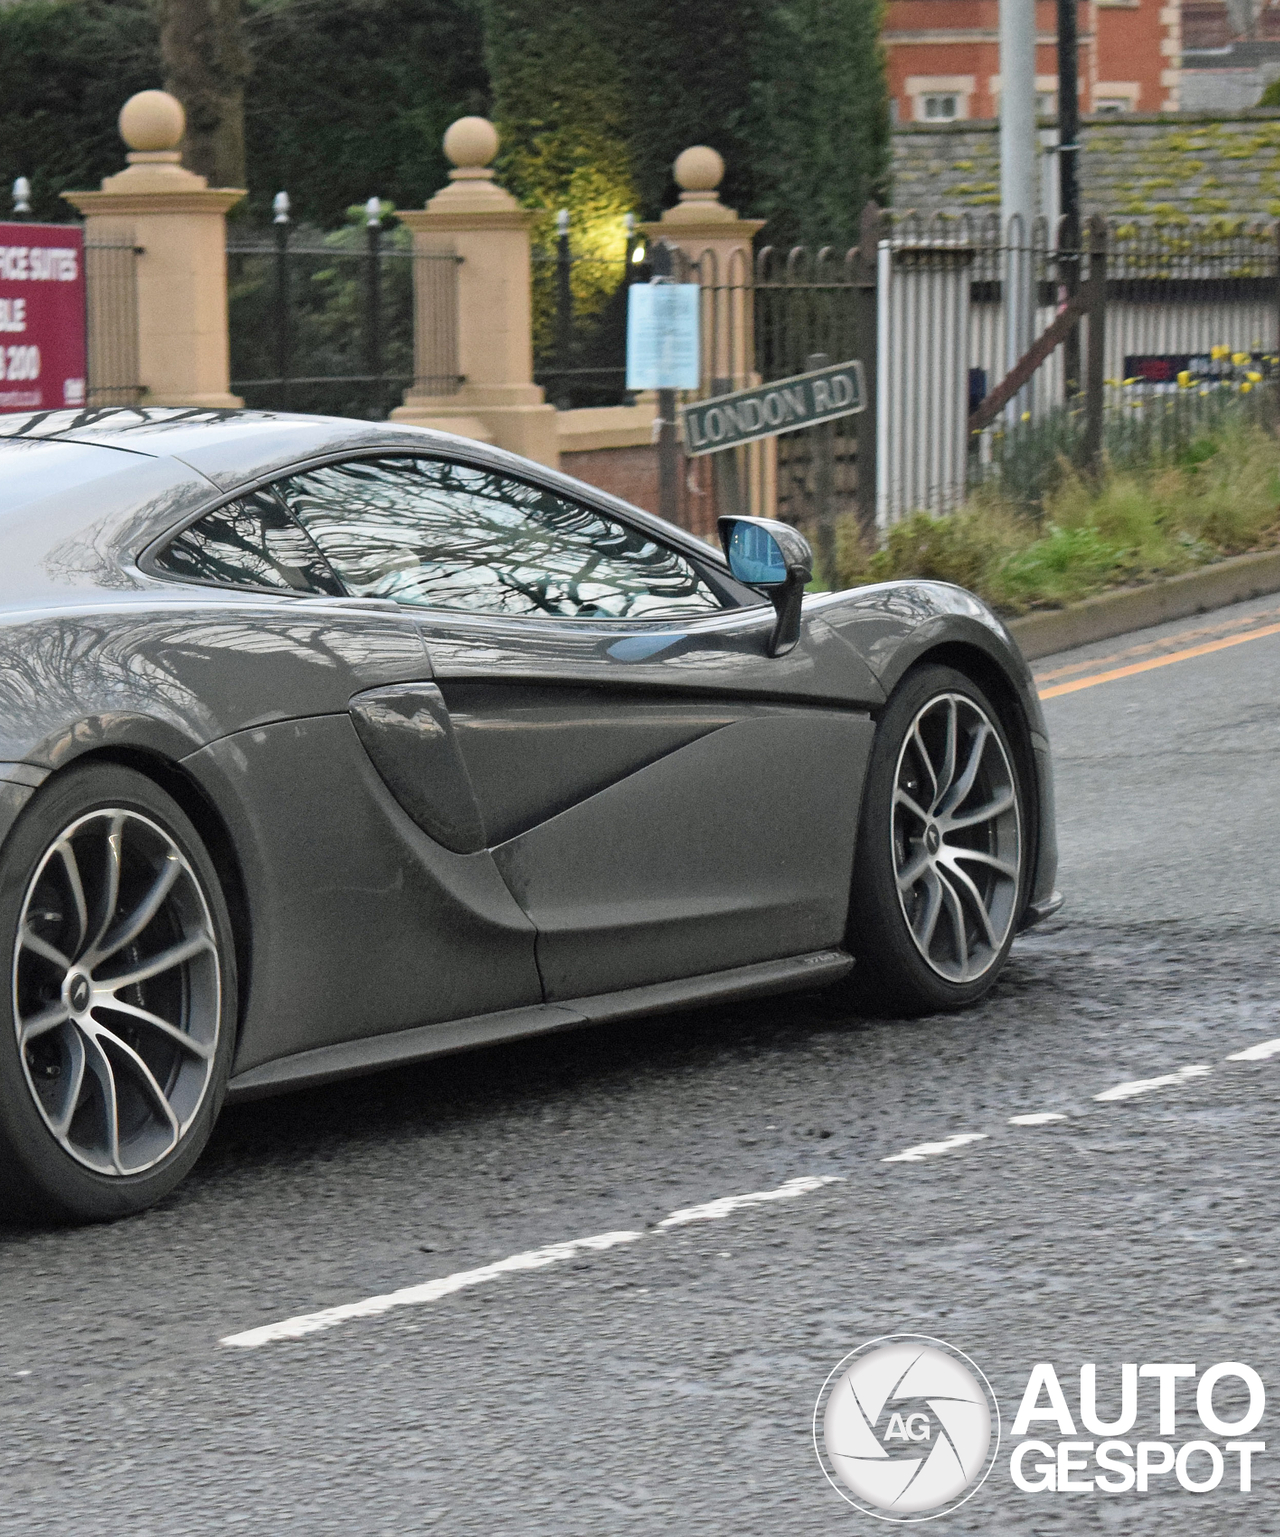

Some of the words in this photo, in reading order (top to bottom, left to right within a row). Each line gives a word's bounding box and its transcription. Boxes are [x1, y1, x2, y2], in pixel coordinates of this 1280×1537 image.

[29, 247, 78, 282] SUITES
[6, 344, 41, 381] 200
[688, 386, 808, 447] LONDON
